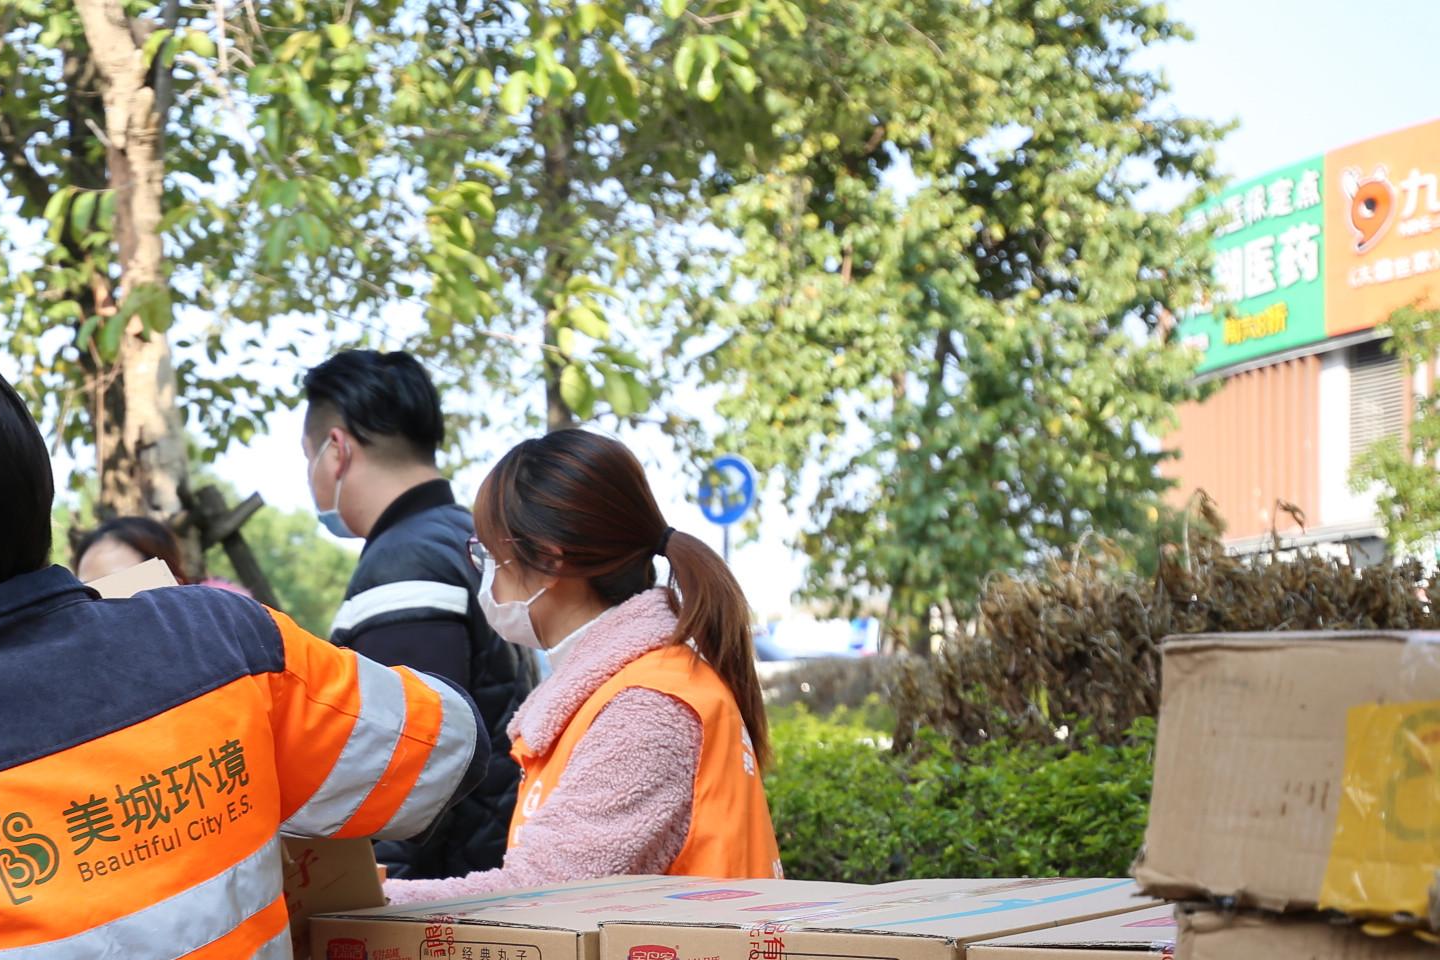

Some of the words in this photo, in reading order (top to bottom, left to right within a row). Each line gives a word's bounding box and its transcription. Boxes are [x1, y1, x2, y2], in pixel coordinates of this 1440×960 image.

[62, 738, 250, 856] 美城环境
[77, 827, 182, 882] Beautiful
[187, 811, 224, 843] City
[226, 794, 253, 824] E.S.
